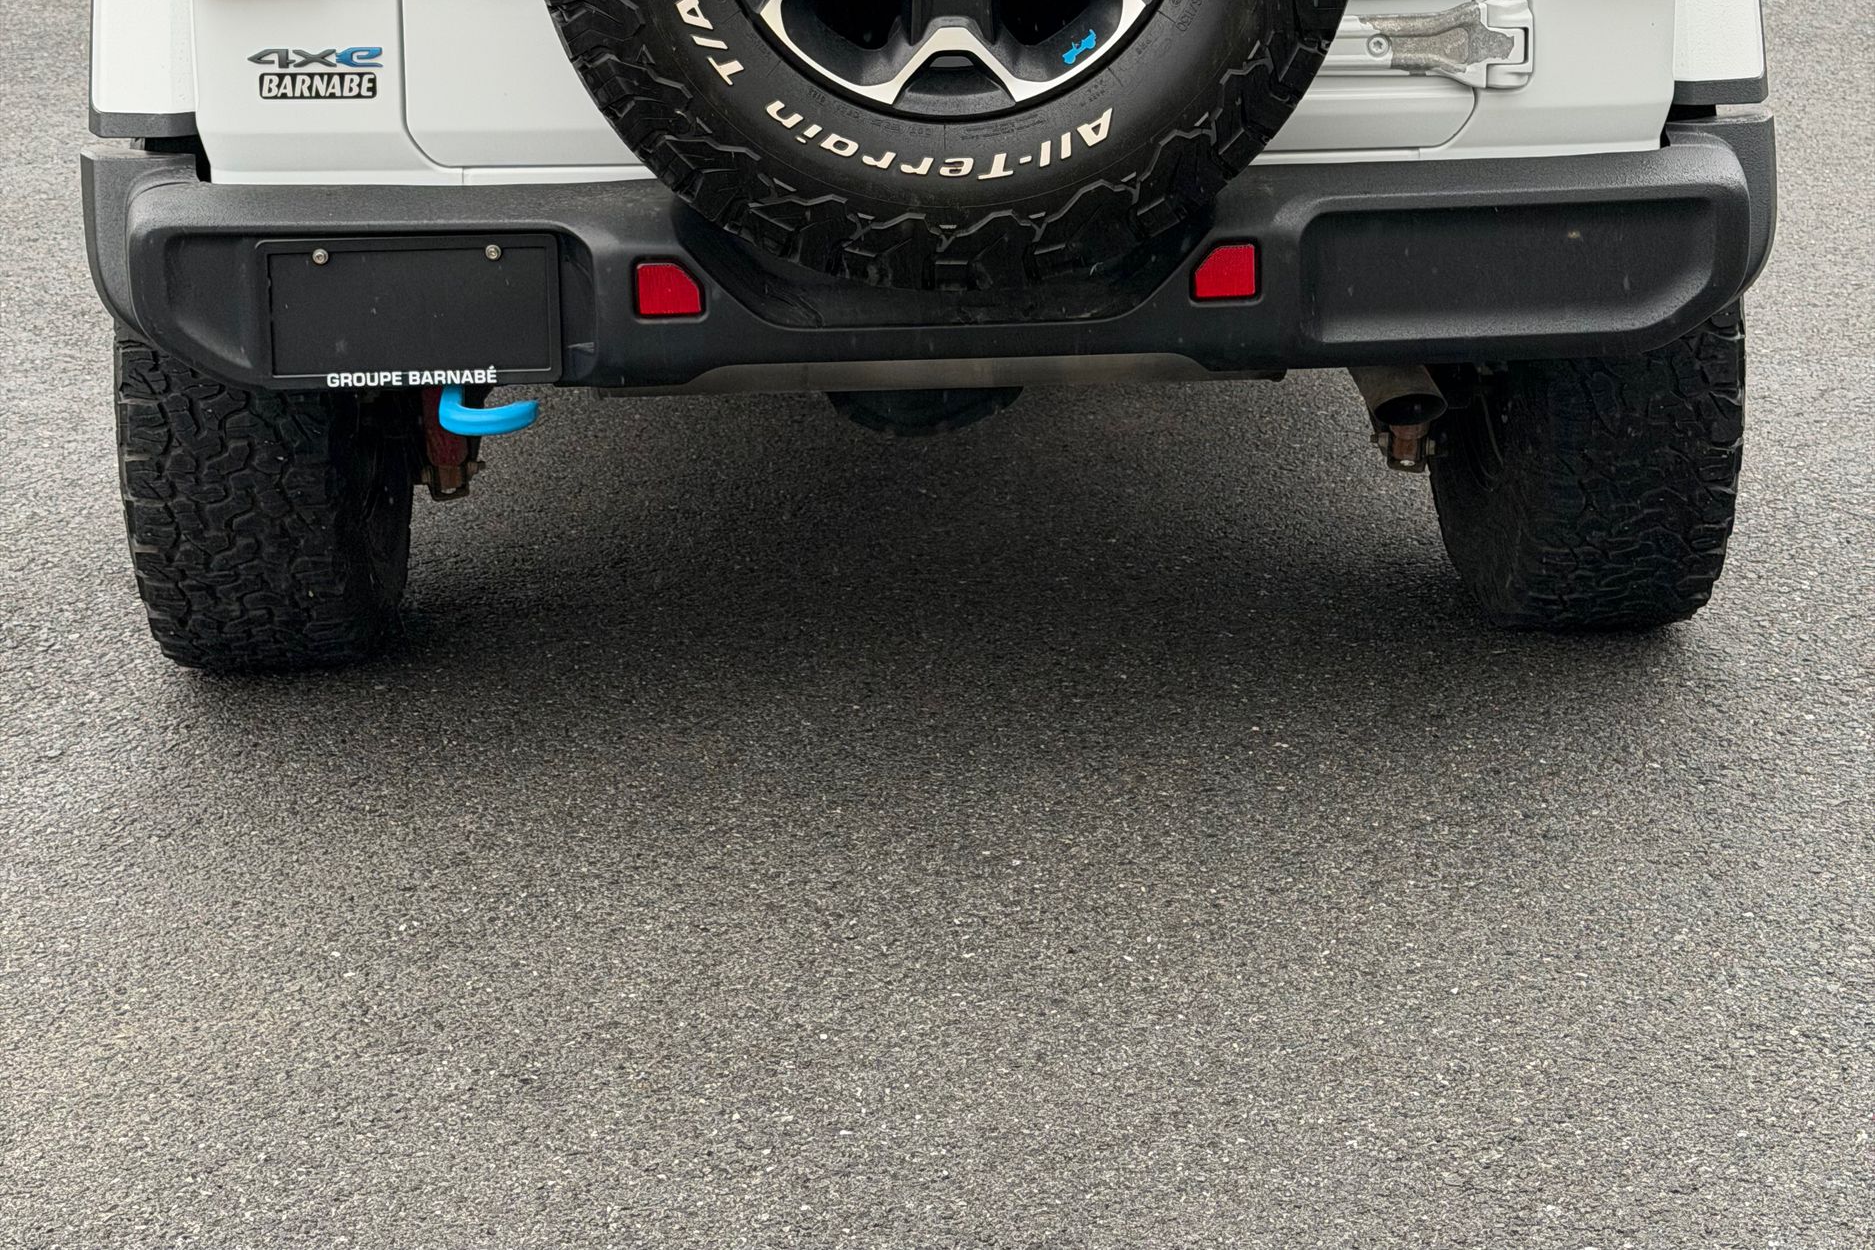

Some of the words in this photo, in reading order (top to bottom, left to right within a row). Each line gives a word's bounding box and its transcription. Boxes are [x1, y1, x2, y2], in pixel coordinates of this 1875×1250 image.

[261, 74, 375, 97] BARNABE
[764, 100, 1114, 181] All-Terrain
[326, 371, 403, 388] GROUPE
[408, 364, 498, 385] BARNABÉ
